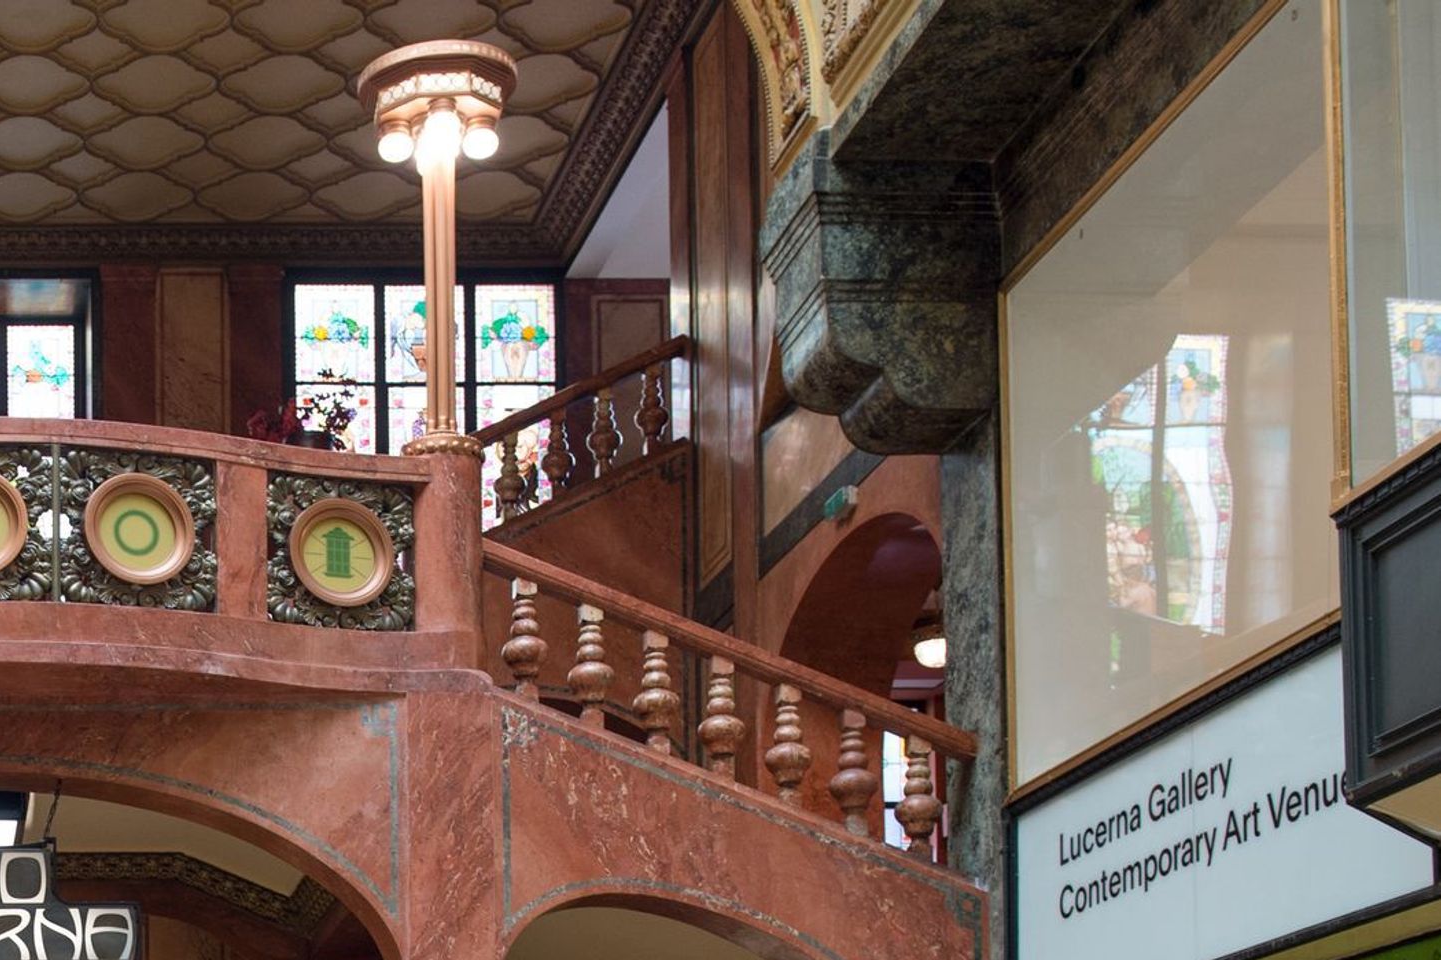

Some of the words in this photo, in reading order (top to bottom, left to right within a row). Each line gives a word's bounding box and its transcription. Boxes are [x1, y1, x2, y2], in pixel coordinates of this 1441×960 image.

[1059, 802, 1141, 867] Lucerna
[1148, 758, 1233, 822] Gallery
[1059, 827, 1217, 919] Contemporary
[1223, 806, 1260, 850] Art
